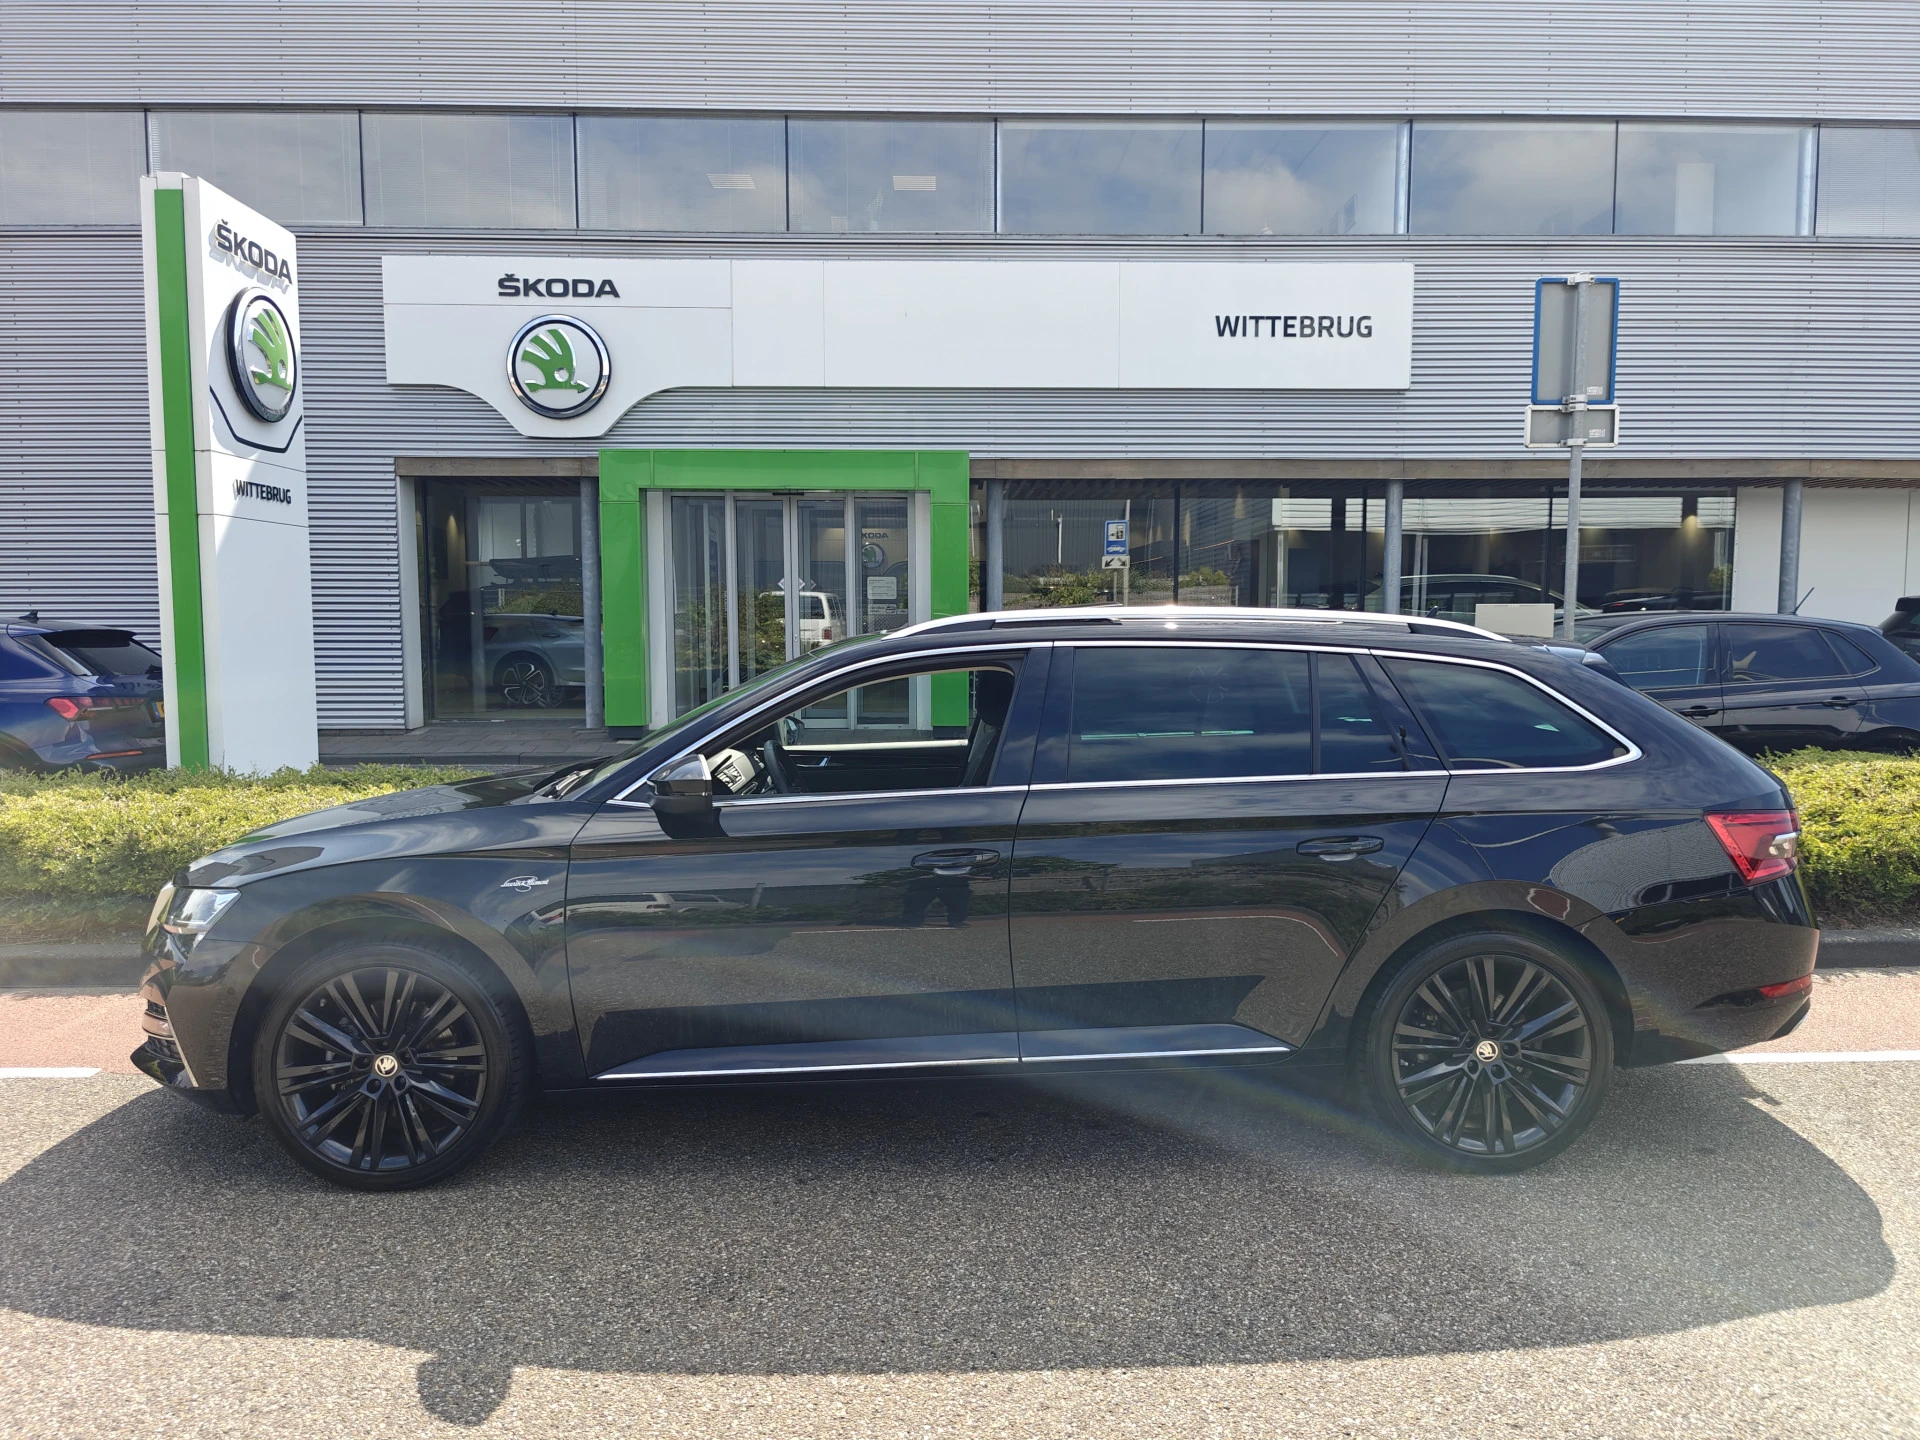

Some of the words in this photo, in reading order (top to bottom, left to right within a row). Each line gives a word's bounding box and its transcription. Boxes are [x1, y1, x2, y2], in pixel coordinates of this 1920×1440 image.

[217, 218, 292, 284] ŠKODA
[497, 273, 621, 298] ŠKODA
[1215, 315, 1373, 338] WITTEBRUG
[235, 479, 292, 504] WITTEBRUG
